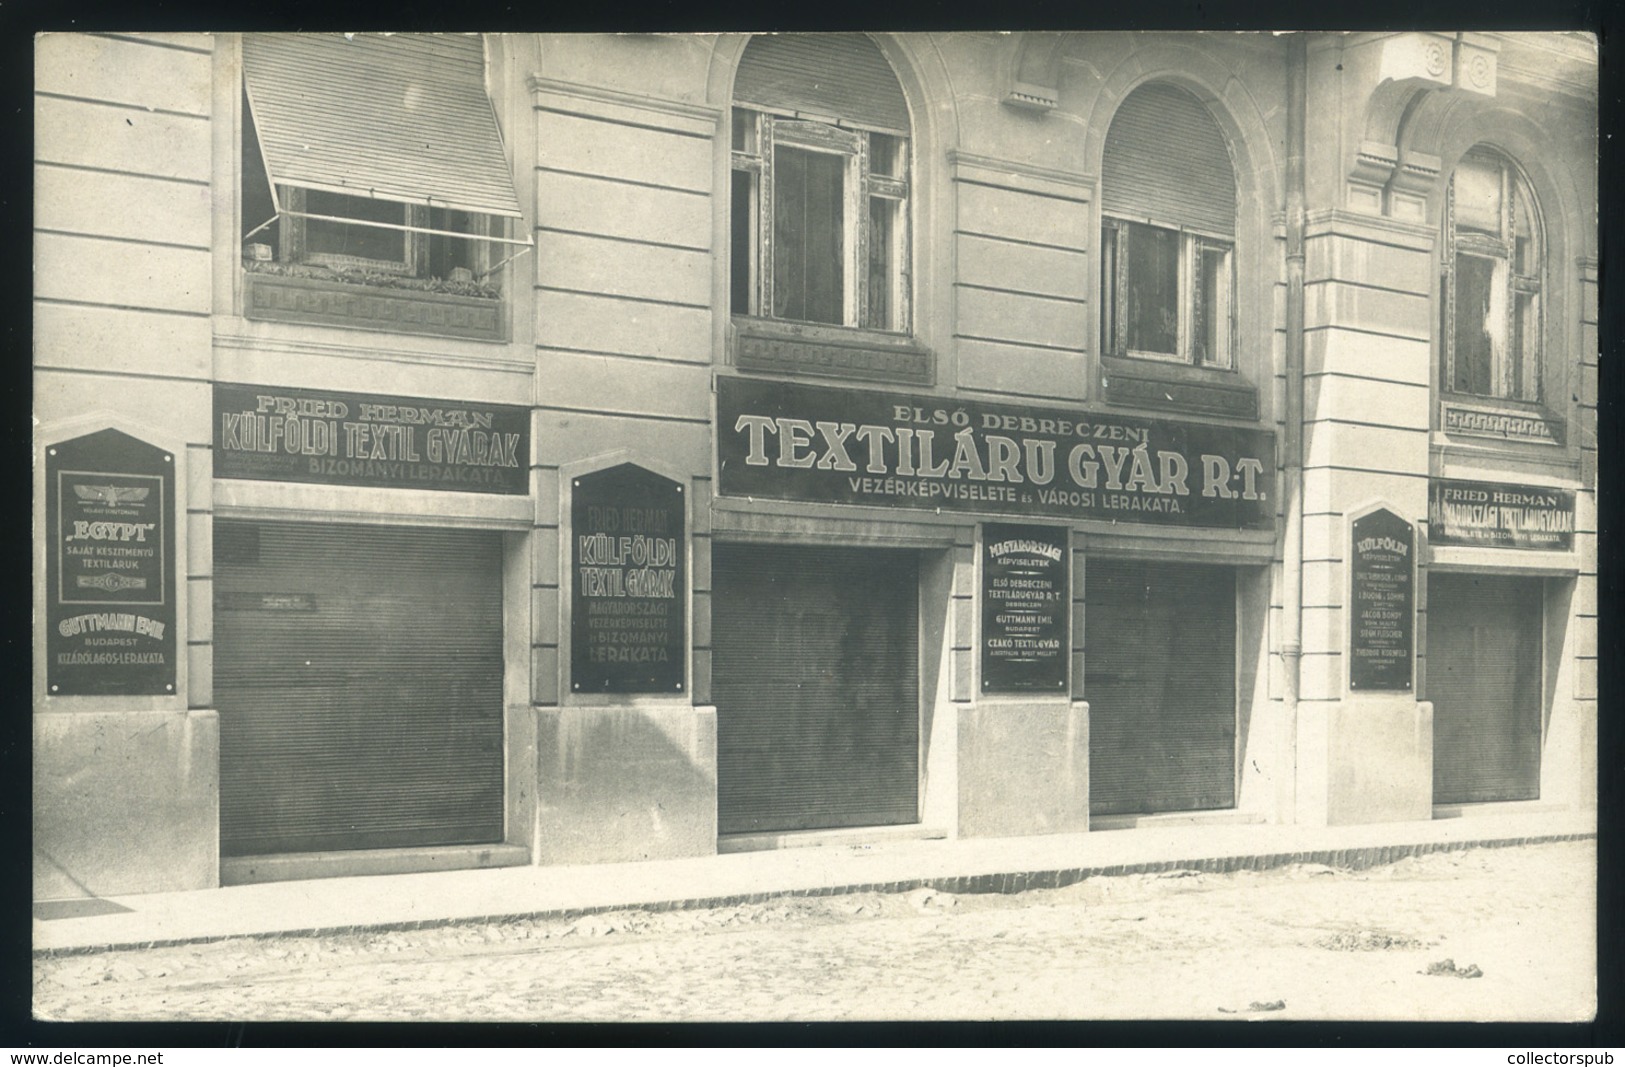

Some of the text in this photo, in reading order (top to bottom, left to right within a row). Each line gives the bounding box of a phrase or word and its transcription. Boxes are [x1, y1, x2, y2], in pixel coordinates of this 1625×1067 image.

[256, 395, 494, 430] FRIED HERMAN
[892, 404, 1150, 443] ELSŐ DEBRECZENI
[222, 411, 520, 468] KÜLFÖLDI TEXTIL GYÁRAK
[734, 414, 1056, 486] TEXTILÁRU
[1067, 443, 1190, 497] GYÁR
[848, 476, 1017, 503] VEZÉRKÉPVISELETE
[1038, 488, 1096, 509] VÁROSI
[1444, 488, 1557, 507] FRIED HERMAN
[588, 505, 668, 534] FRIED HERMAN
[66, 545, 94, 556] SAJÁT
[579, 532, 676, 567] KÜLFÖLDI
[1356, 537, 1408, 557] KÜLFÖLDI
[579, 565, 675, 599] TEXTIL GYÁRAK
[1009, 579, 1053, 589] DEBRECZENI
[59, 613, 165, 642] GUTTMANN EMIL
[995, 614, 1053, 625] GUTTMANN EMIL
[85, 639, 138, 647] BUDAPEST
[589, 647, 669, 663] LERAKATA
